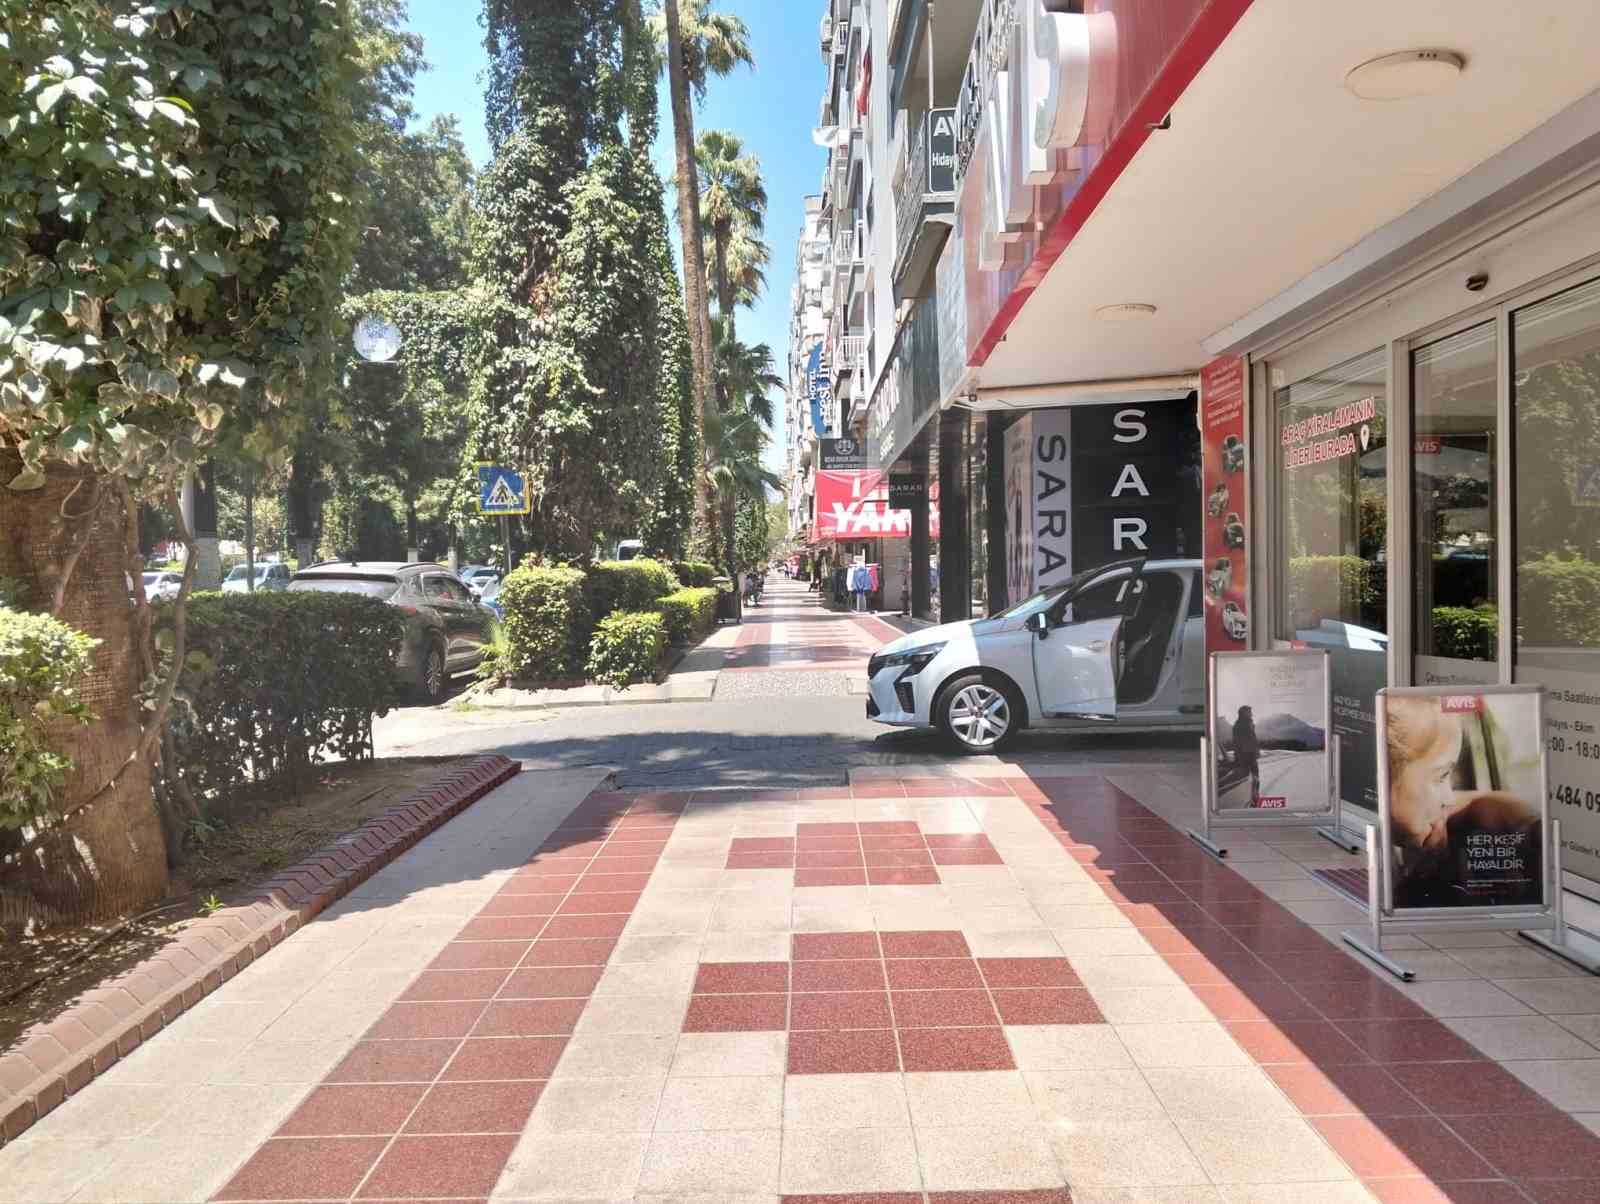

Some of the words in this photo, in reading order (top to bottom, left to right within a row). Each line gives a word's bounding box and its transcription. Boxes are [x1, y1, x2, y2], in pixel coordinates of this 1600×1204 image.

[809, 368, 817, 401] HOTEL
[1314, 432, 1356, 463] BURADA
[1415, 441, 1437, 453] VIS
[1037, 434, 1067, 592] SARA
[1446, 696, 1476, 709] AVIS
[1260, 799, 1283, 808] AVIS
[1466, 833, 1493, 846] HER
